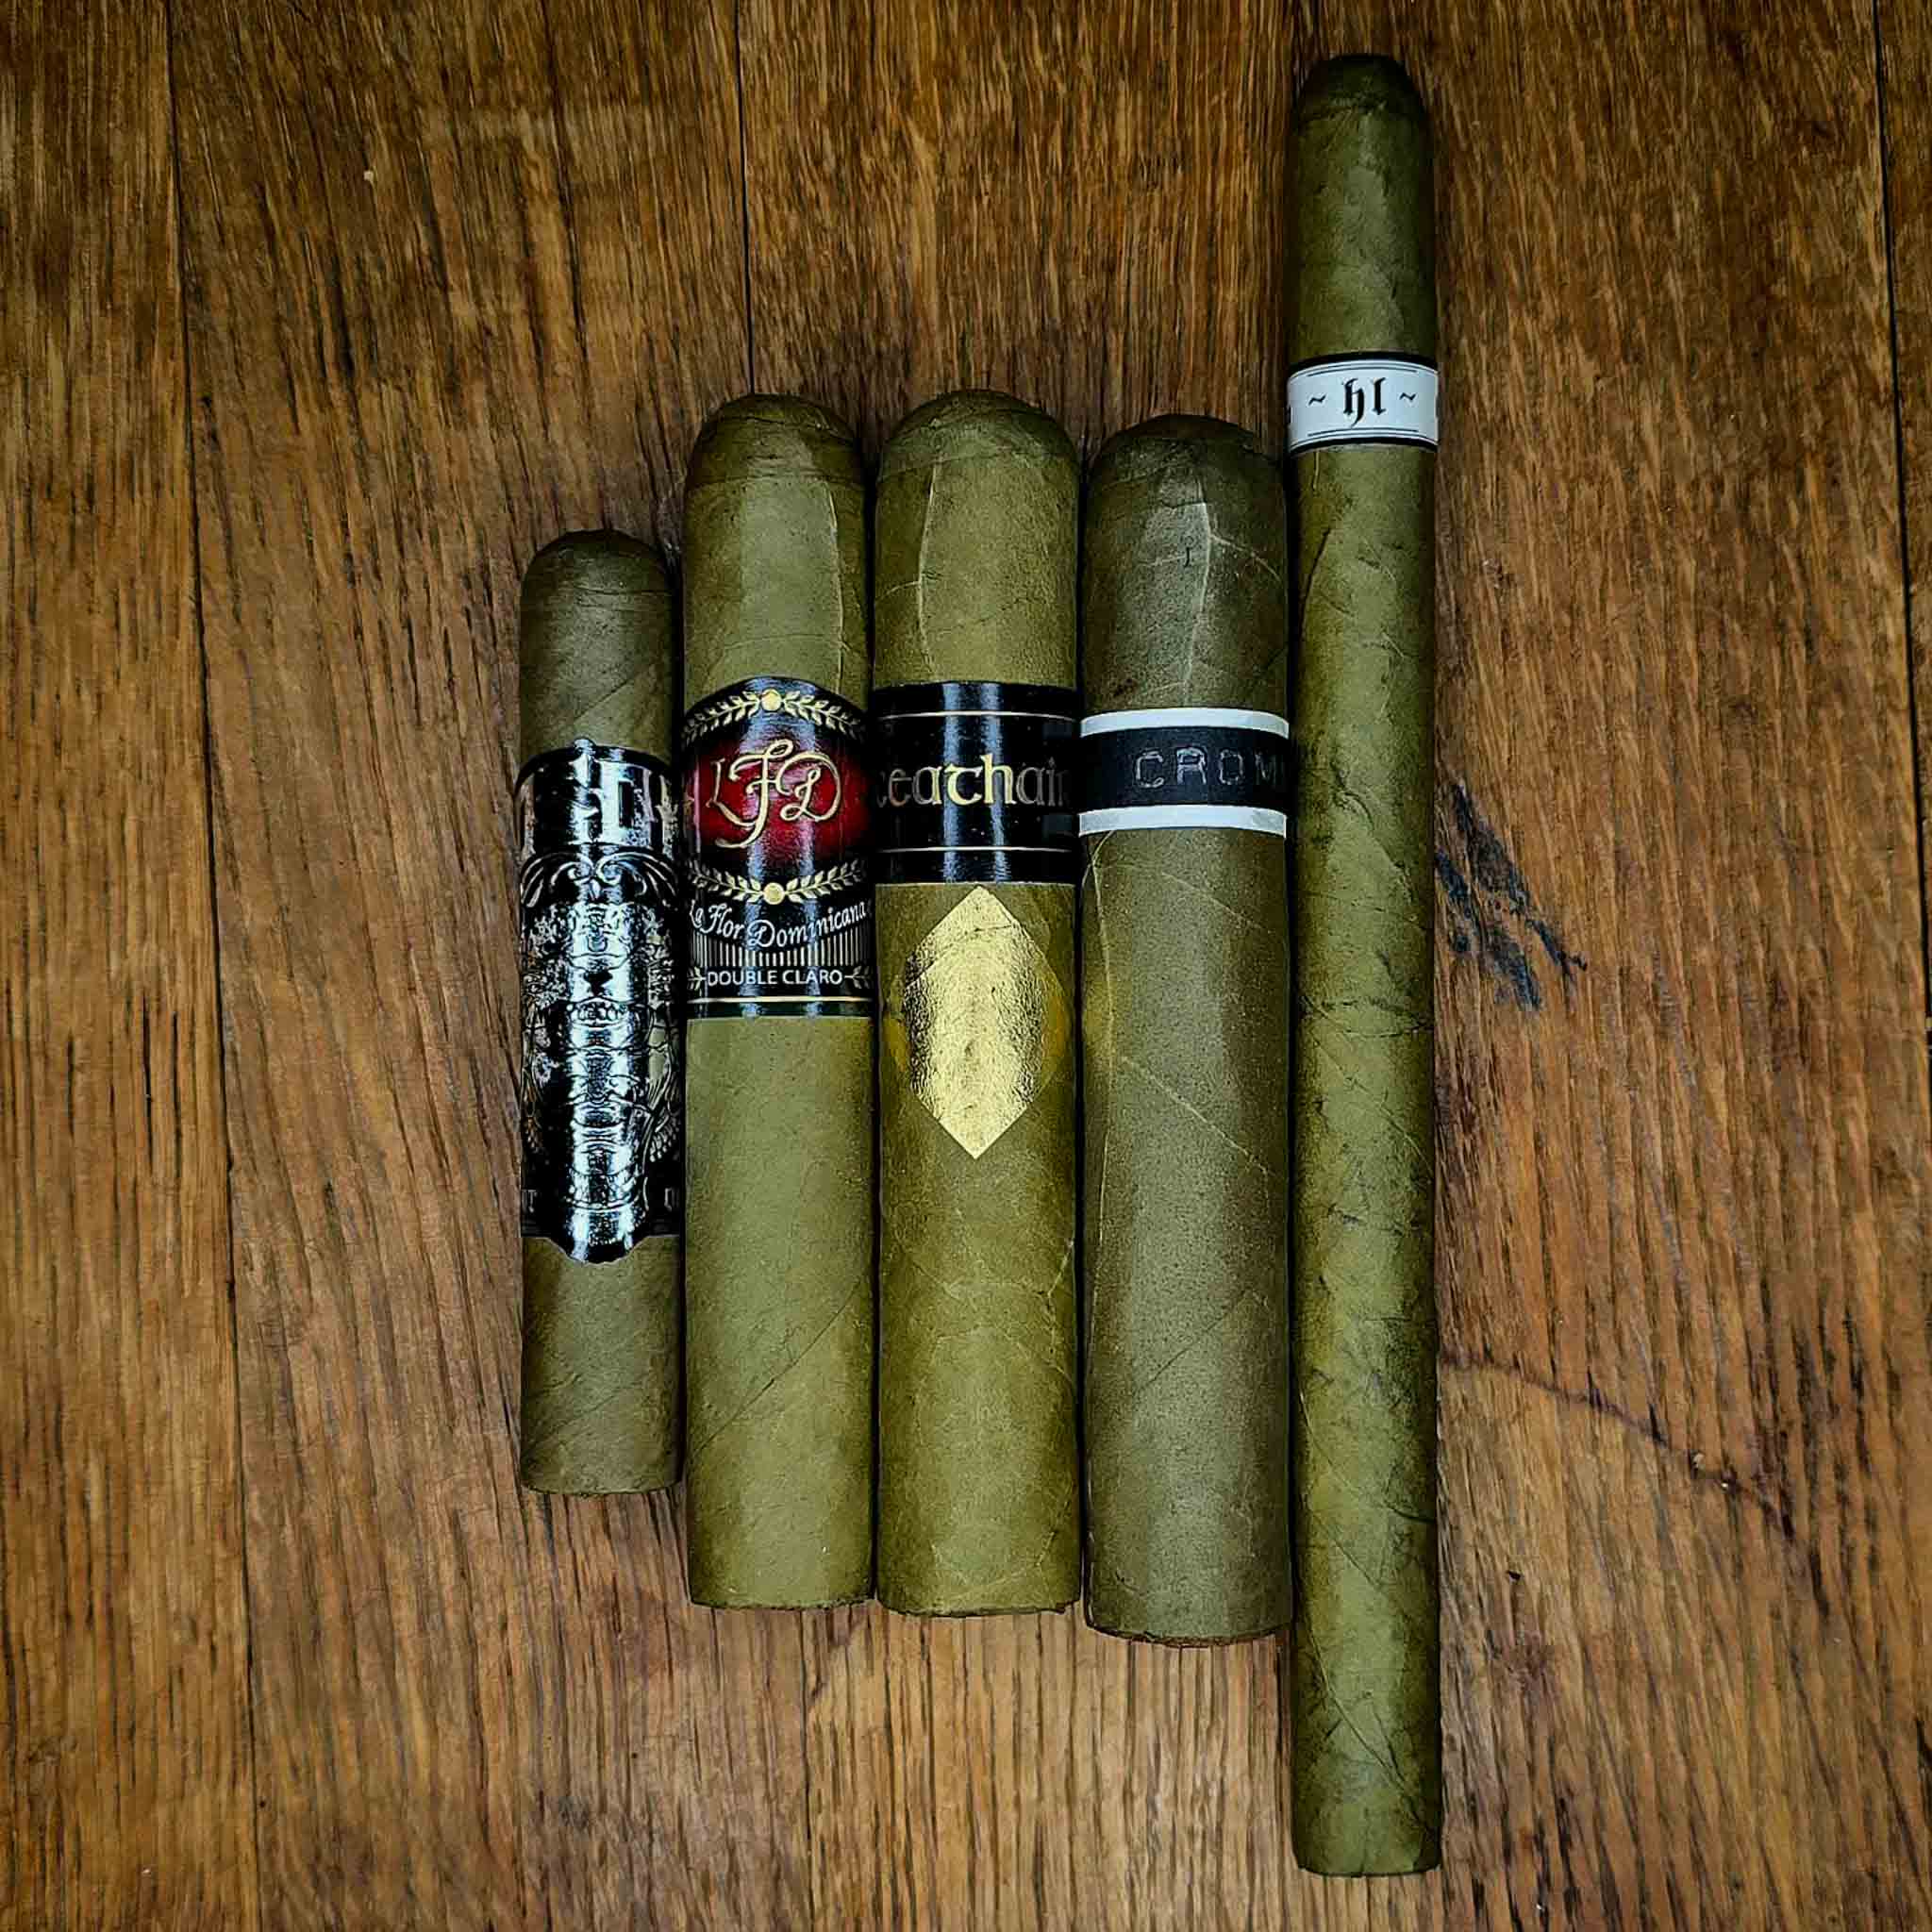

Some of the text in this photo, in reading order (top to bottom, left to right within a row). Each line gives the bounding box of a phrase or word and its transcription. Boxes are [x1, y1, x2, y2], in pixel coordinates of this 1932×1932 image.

[689, 899, 869, 948] La Flor Dominicana
[708, 969, 843, 987] DOUBLE CLARO
